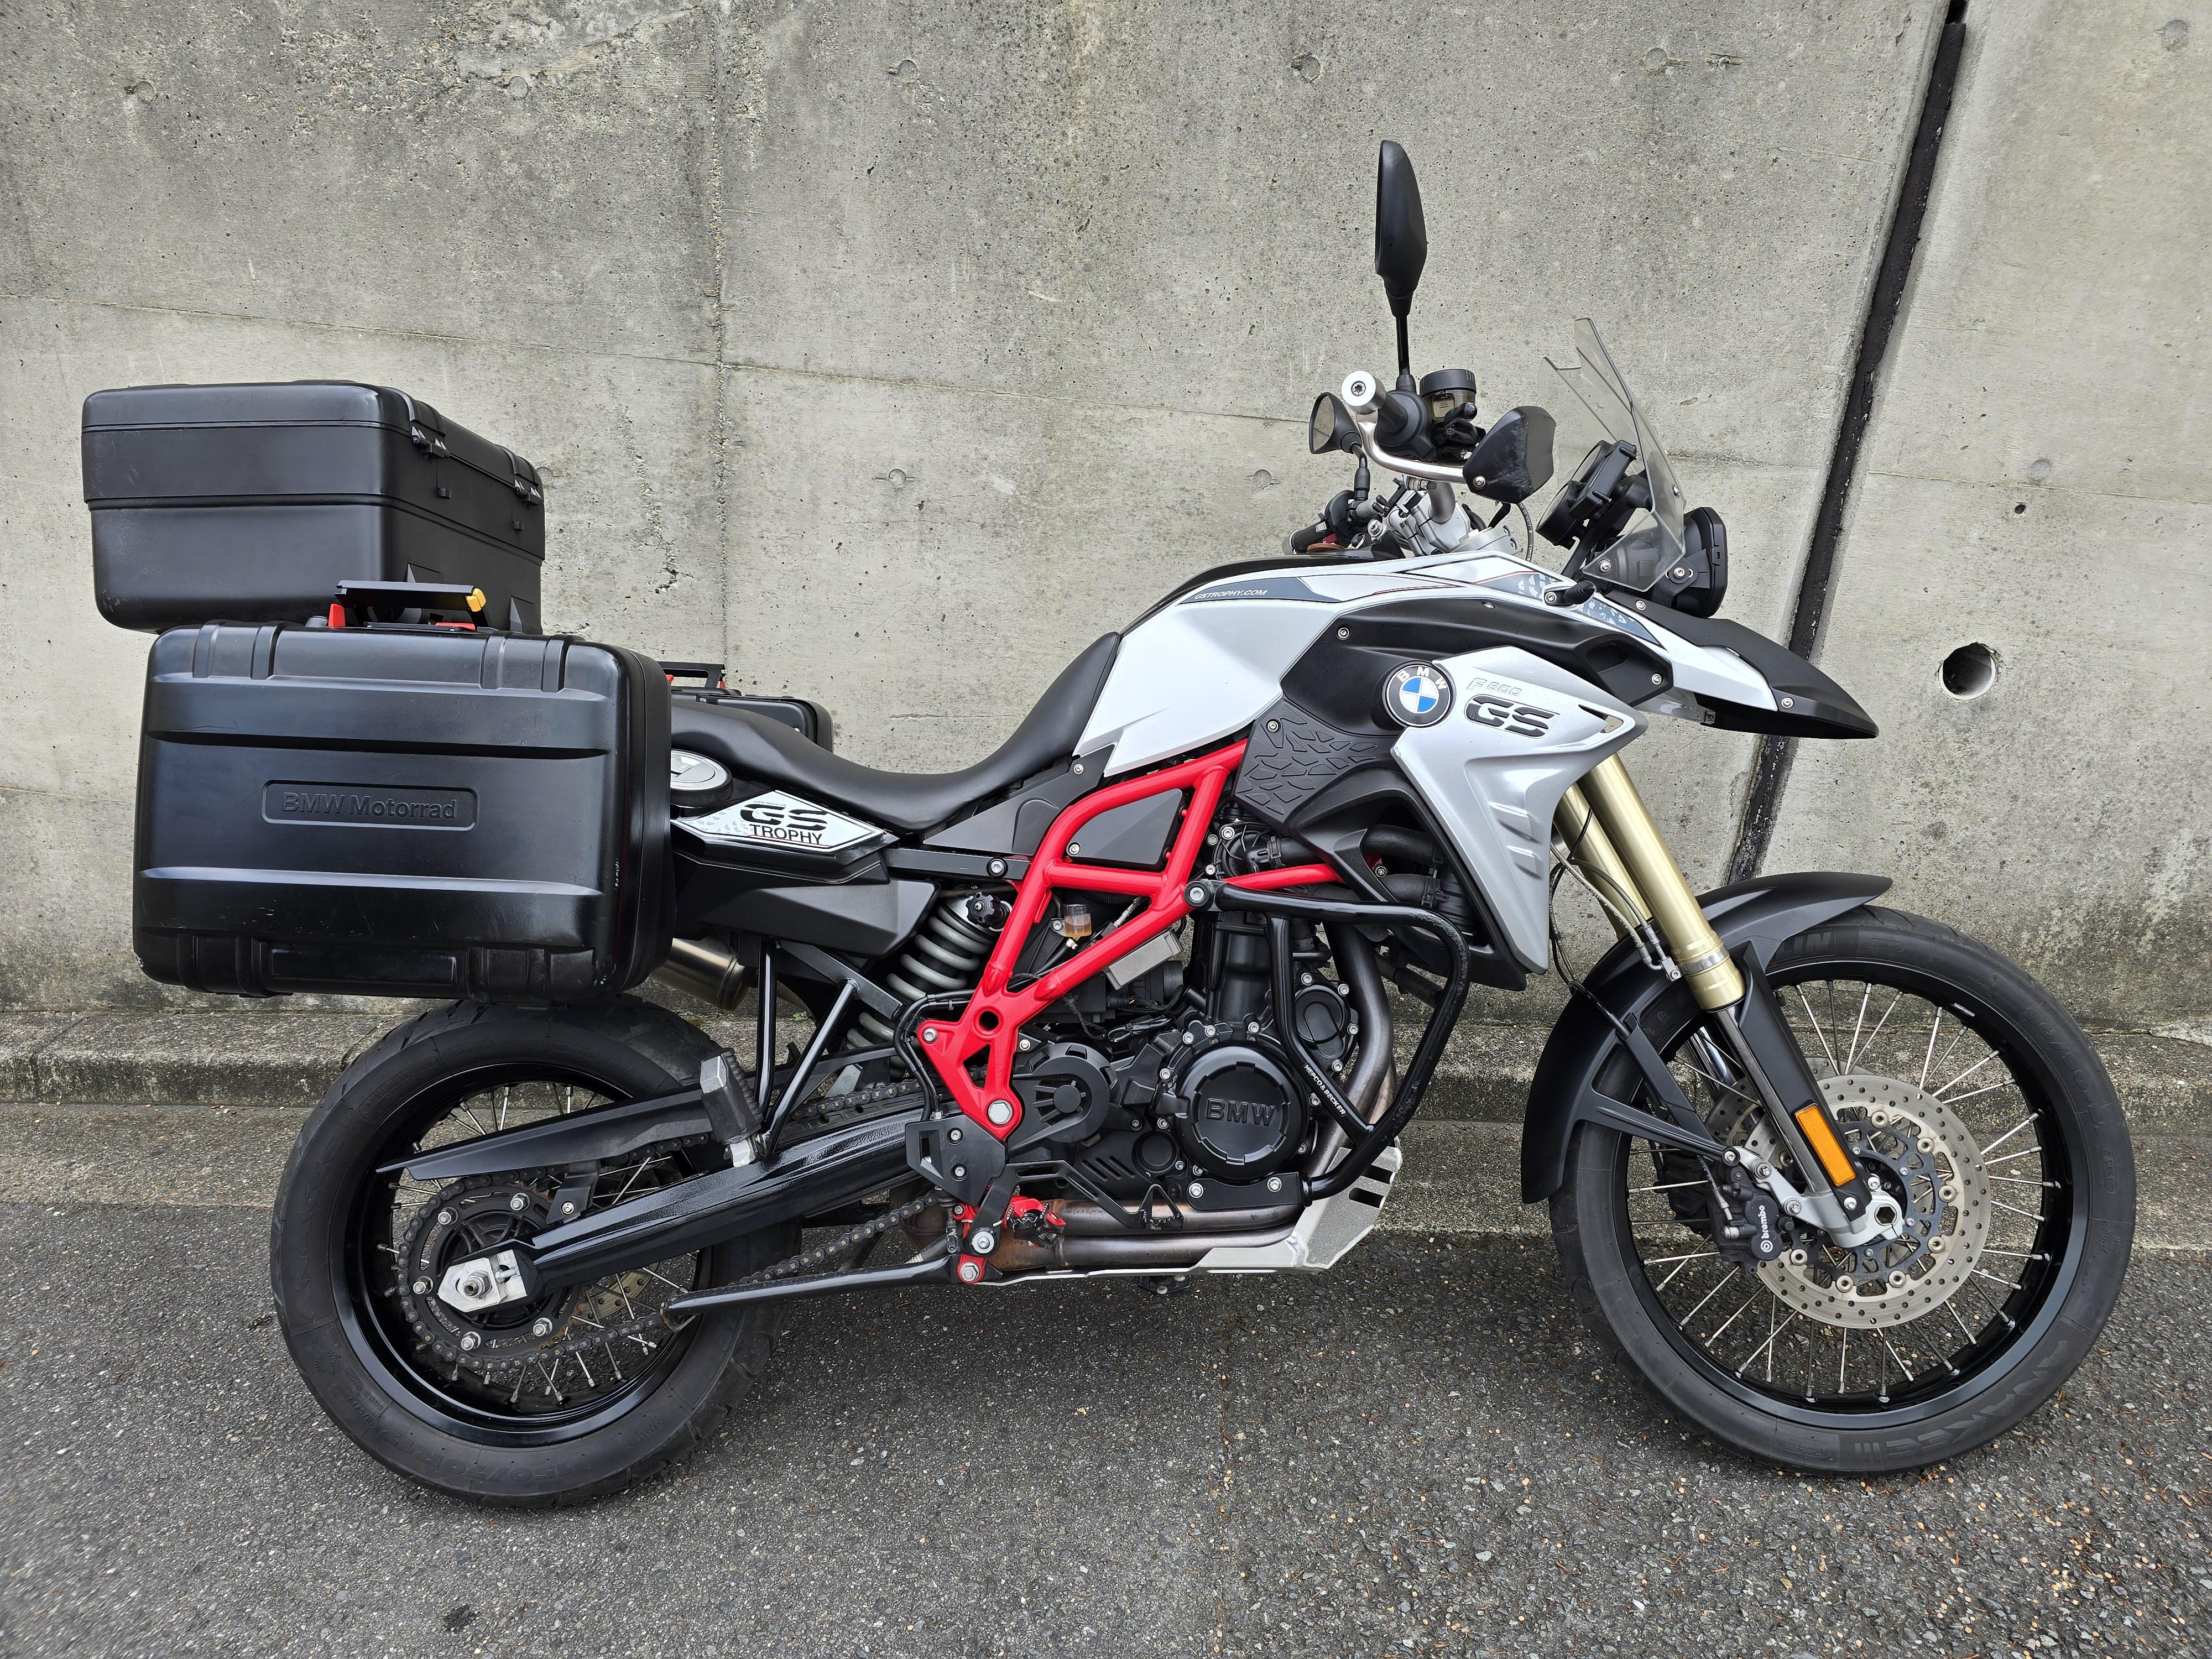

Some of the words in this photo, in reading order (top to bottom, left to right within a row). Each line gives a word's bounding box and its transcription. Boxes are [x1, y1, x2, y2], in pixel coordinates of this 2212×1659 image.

[1194, 589, 1268, 599] GSTROPHY.COM
[1396, 666, 1448, 690] BMW
[1466, 677, 1487, 691] F
[1487, 681, 1522, 696] 800
[1465, 695, 1555, 738] GS
[282, 792, 345, 813] BMW
[349, 795, 458, 820] Motorrad
[740, 804, 828, 831] GS
[749, 823, 823, 845] TROPHY
[1206, 1098, 1276, 1127] BMW
[1758, 1205, 1770, 1239] brembo
